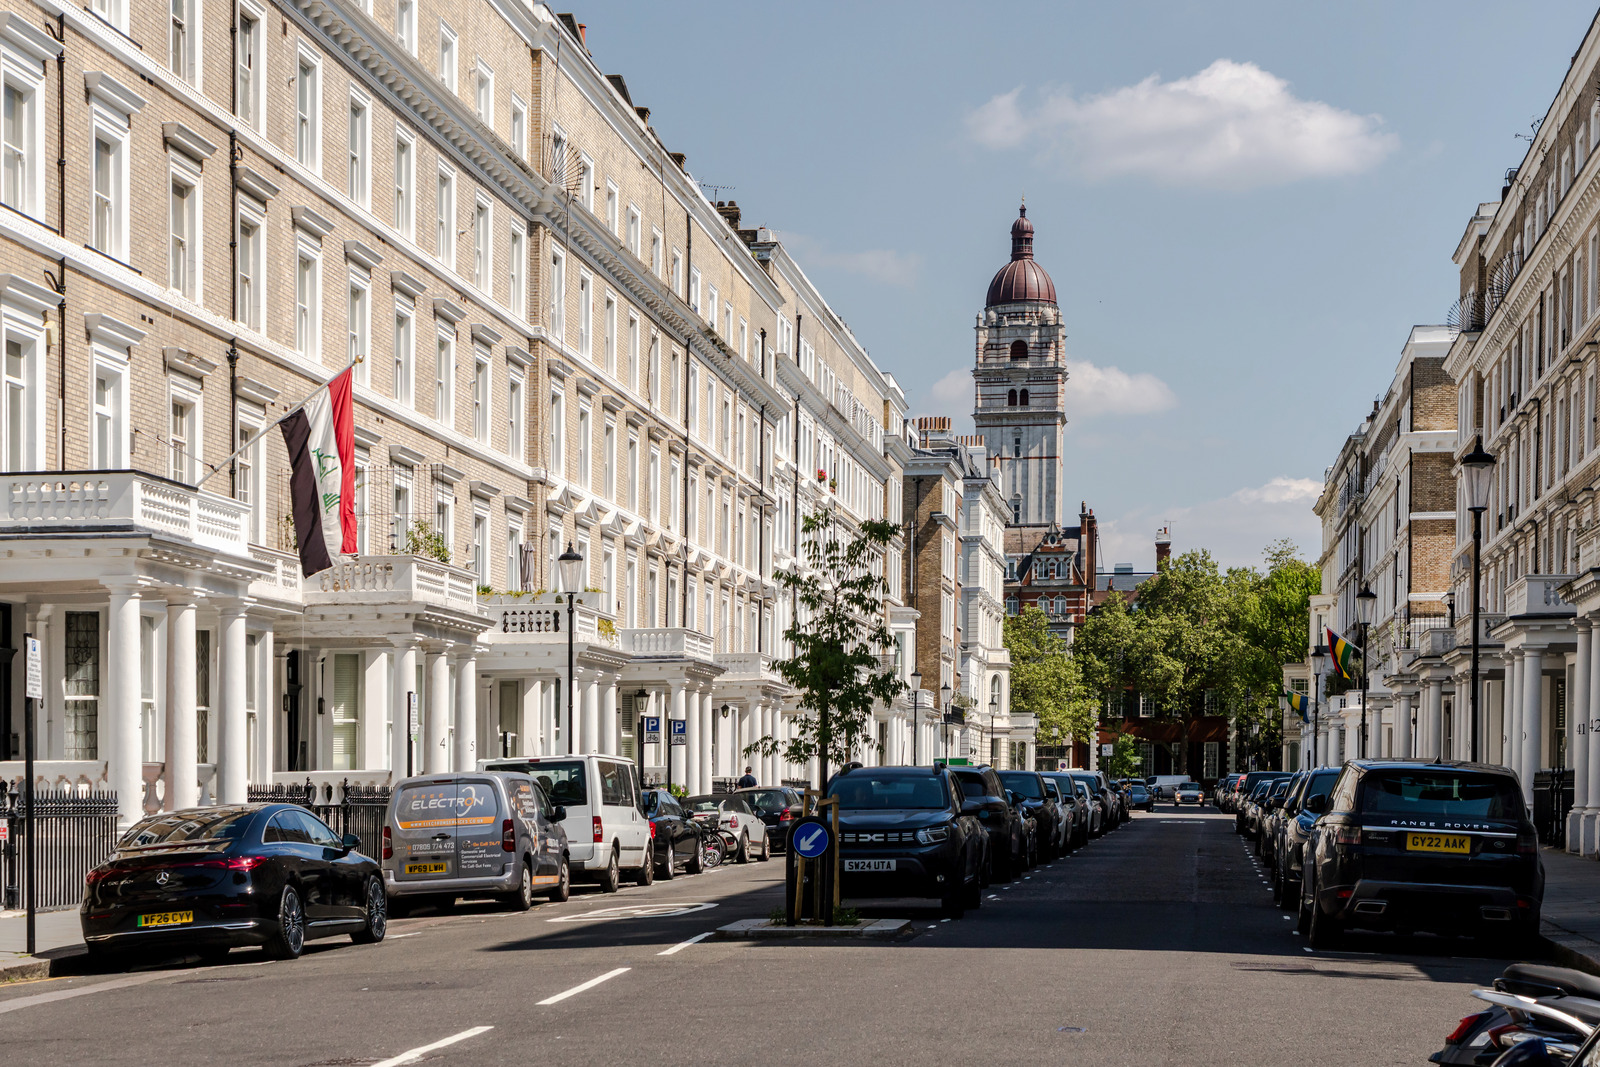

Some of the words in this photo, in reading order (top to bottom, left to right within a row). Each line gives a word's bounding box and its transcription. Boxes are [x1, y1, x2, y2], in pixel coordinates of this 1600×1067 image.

[648, 719, 657, 731] P
[675, 722, 684, 733] P
[1576, 723, 1585, 735] 41
[1589, 718, 1600, 732] 42
[440, 738, 446, 749] 4
[470, 741, 475, 752] 5
[411, 797, 485, 811] ELECTRON
[1444, 822, 1490, 830] ROVER
[1412, 836, 1441, 848] GY22
[1444, 838, 1465, 849] AAK
[408, 864, 428, 873] WP69
[429, 863, 444, 872] LWH
[848, 861, 871, 870] SW24
[874, 861, 892, 870] UTA
[144, 914, 169, 924] WF26
[171, 911, 191, 922] CYY
